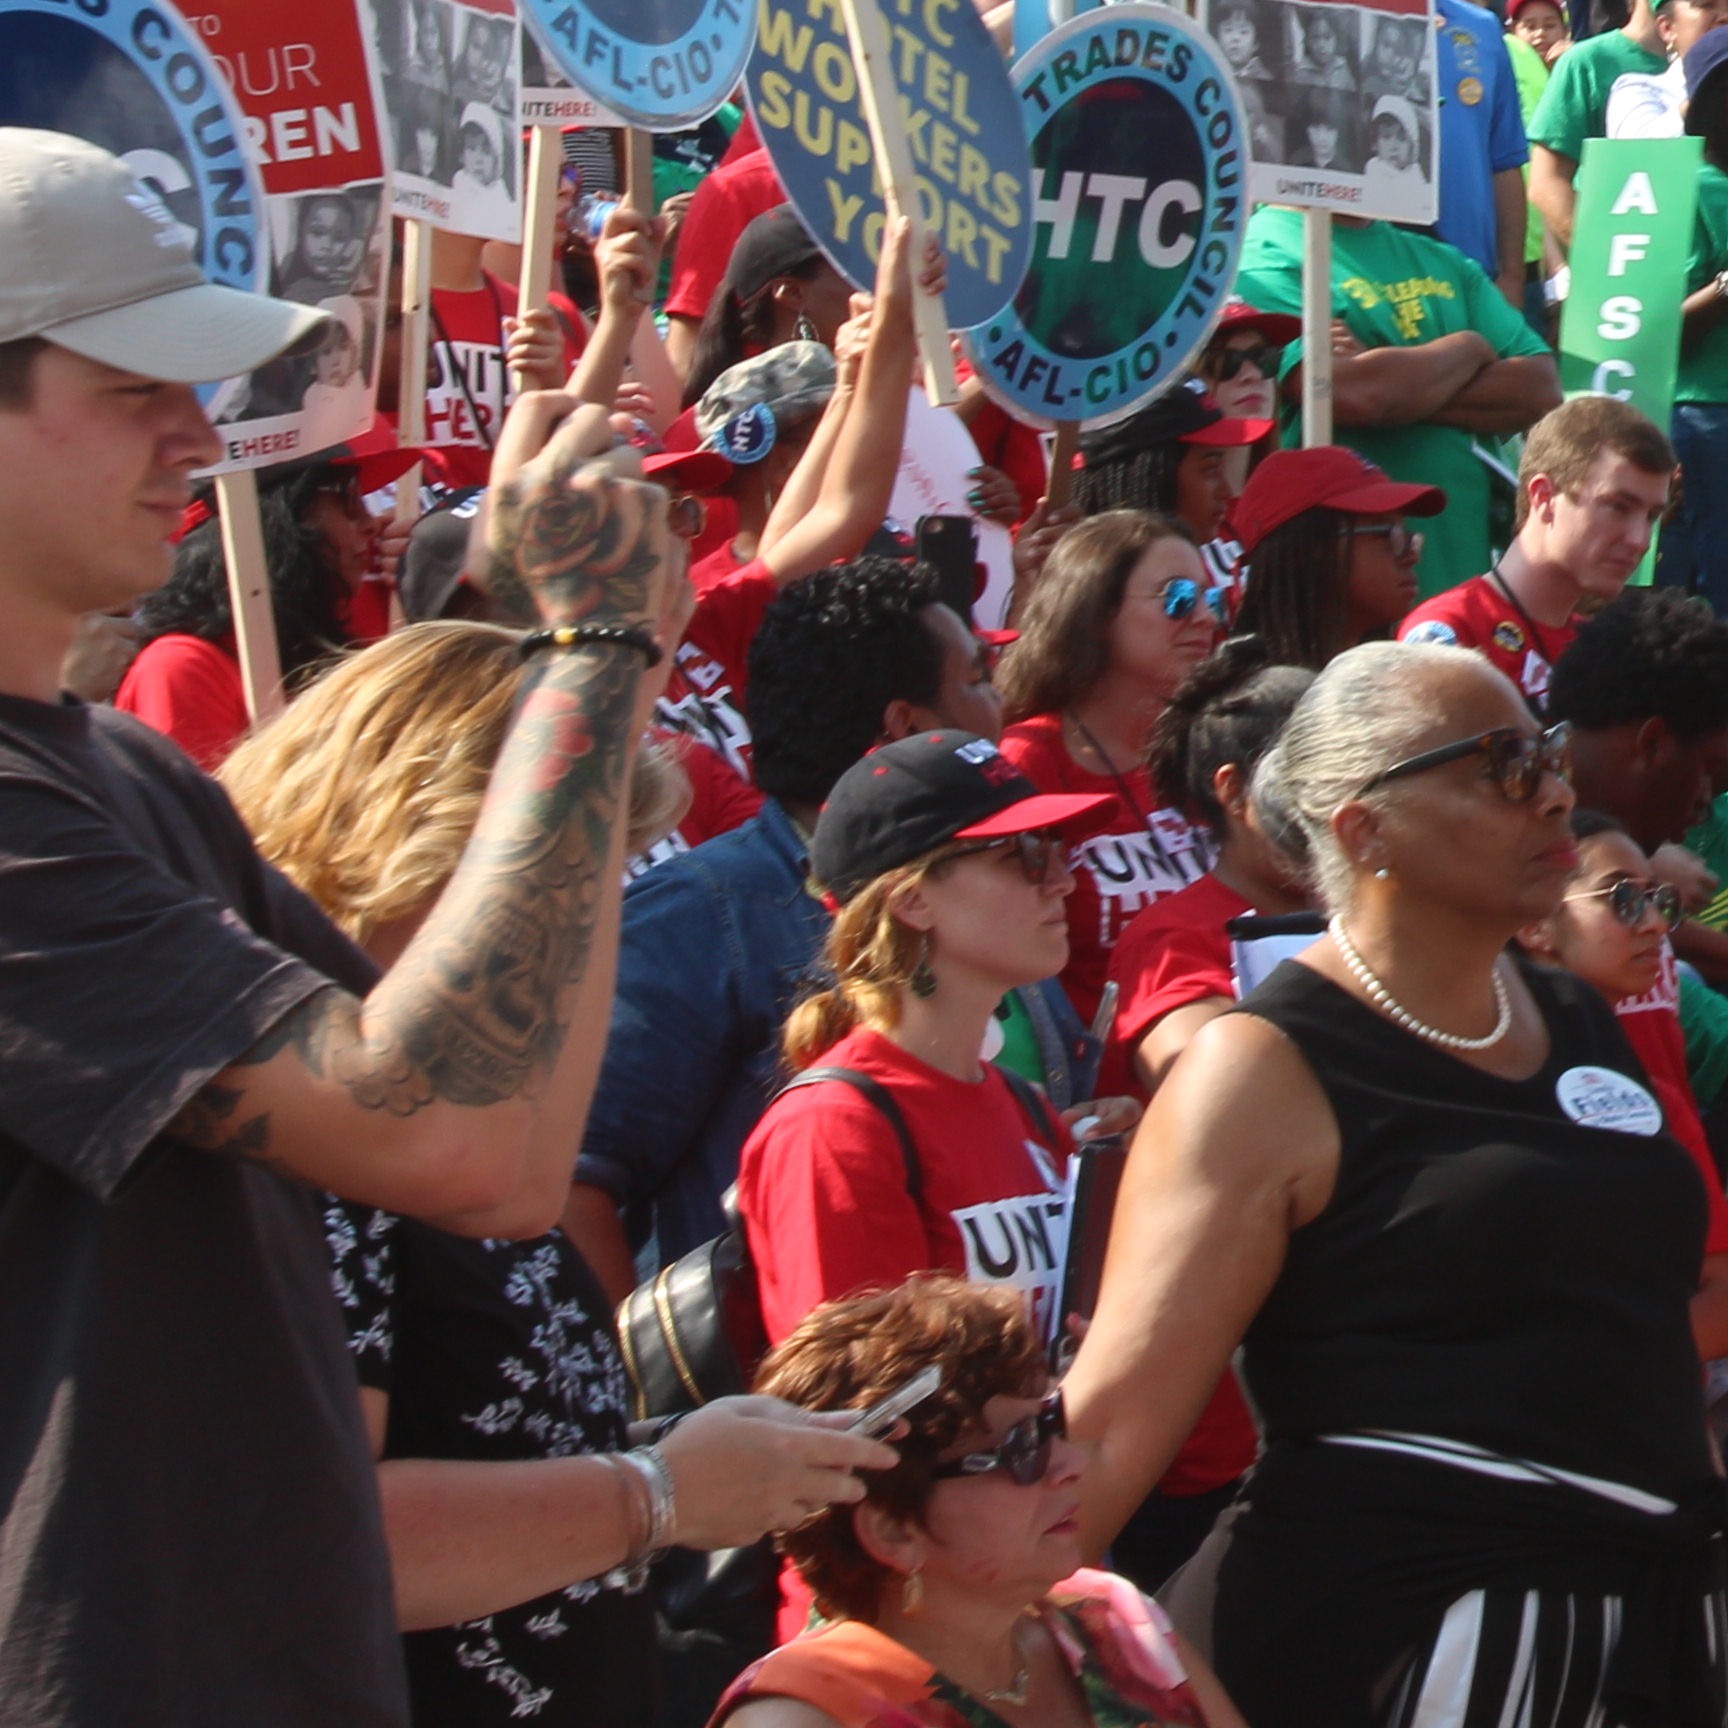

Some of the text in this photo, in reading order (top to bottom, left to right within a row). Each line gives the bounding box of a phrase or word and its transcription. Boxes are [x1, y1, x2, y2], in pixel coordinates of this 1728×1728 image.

[551, 4, 716, 100] AFL-CIO
[131, 8, 257, 280] COUNC
[522, 99, 597, 119] ITEHERE!
[759, 71, 1011, 284] SUPORT
[826, 178, 882, 263] YO
[1022, 29, 1240, 321] TRADES COUNCIL
[1032, 168, 1203, 270] HTC
[1592, 171, 1659, 402] AFSC
[992, 340, 1162, 405] AFL-CIO
[228, 429, 297, 460] EHERE!
[733, 411, 756, 452] HTC
